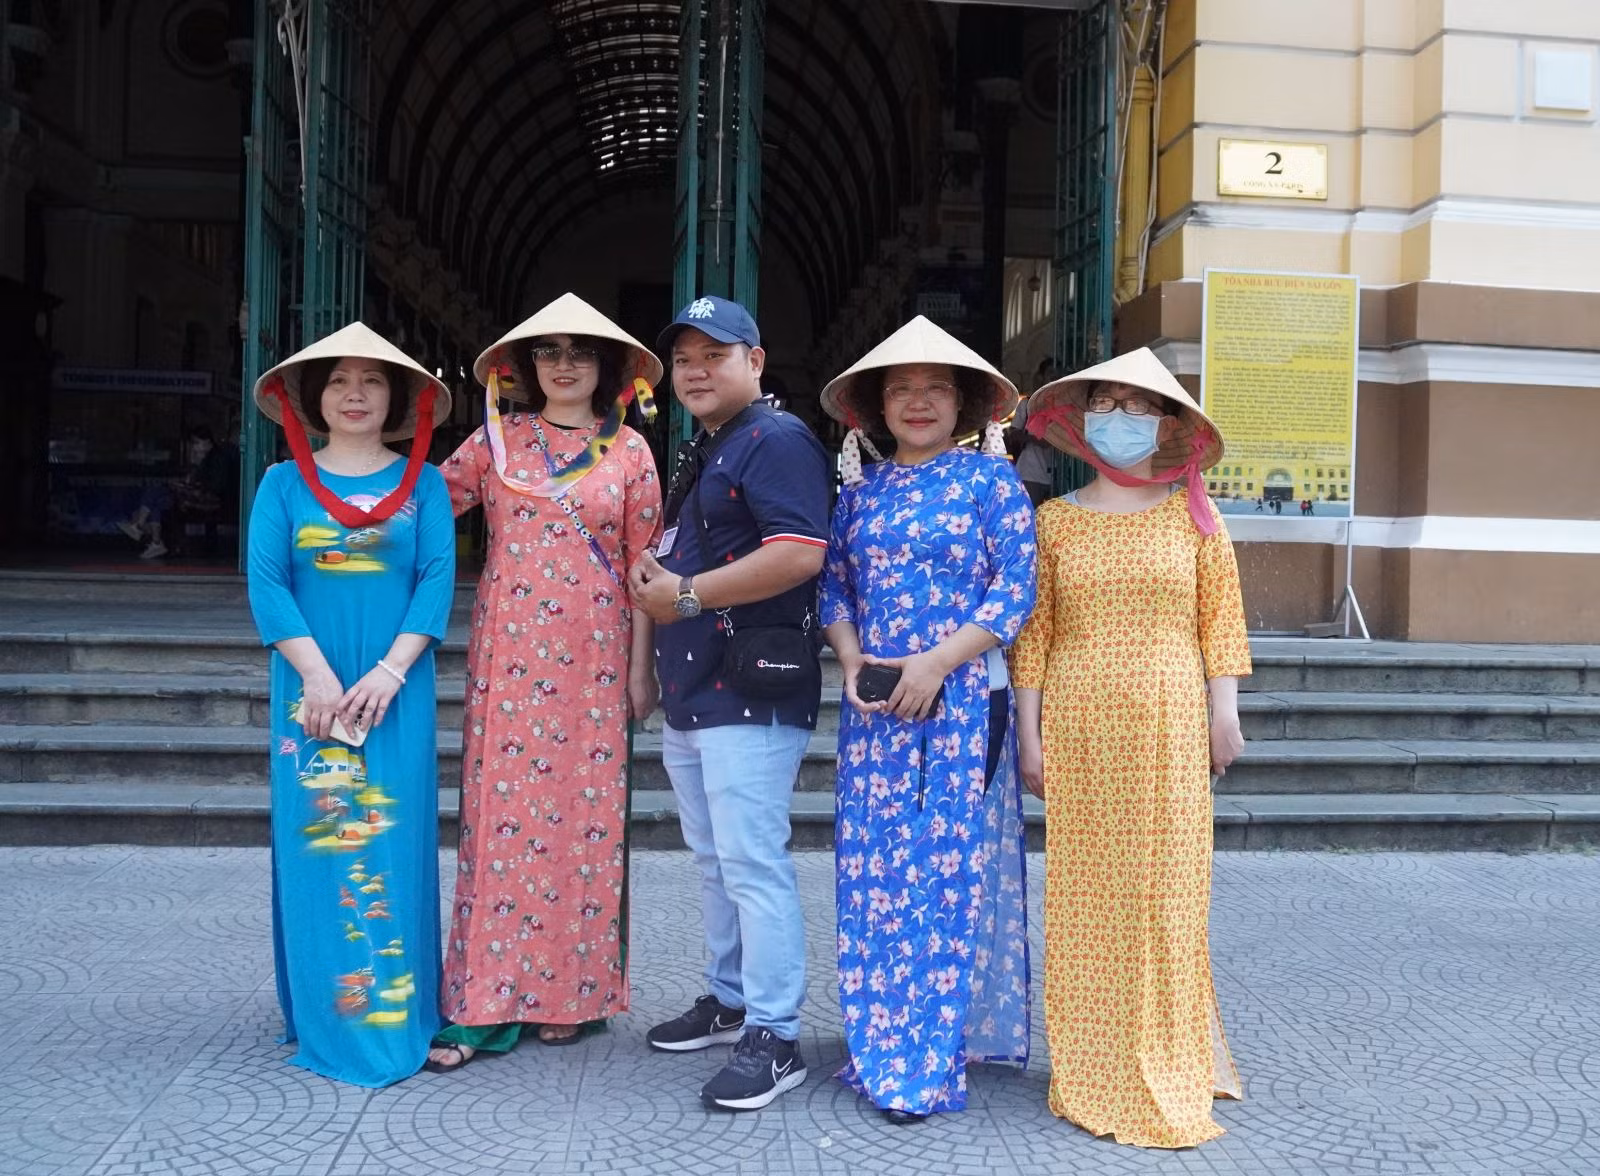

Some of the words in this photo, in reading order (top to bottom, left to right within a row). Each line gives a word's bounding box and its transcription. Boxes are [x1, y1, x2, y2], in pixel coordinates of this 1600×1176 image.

[1264, 151, 1283, 175] 2
[117, 375, 206, 387] INFORMATION
[757, 659, 800, 671] Champion
